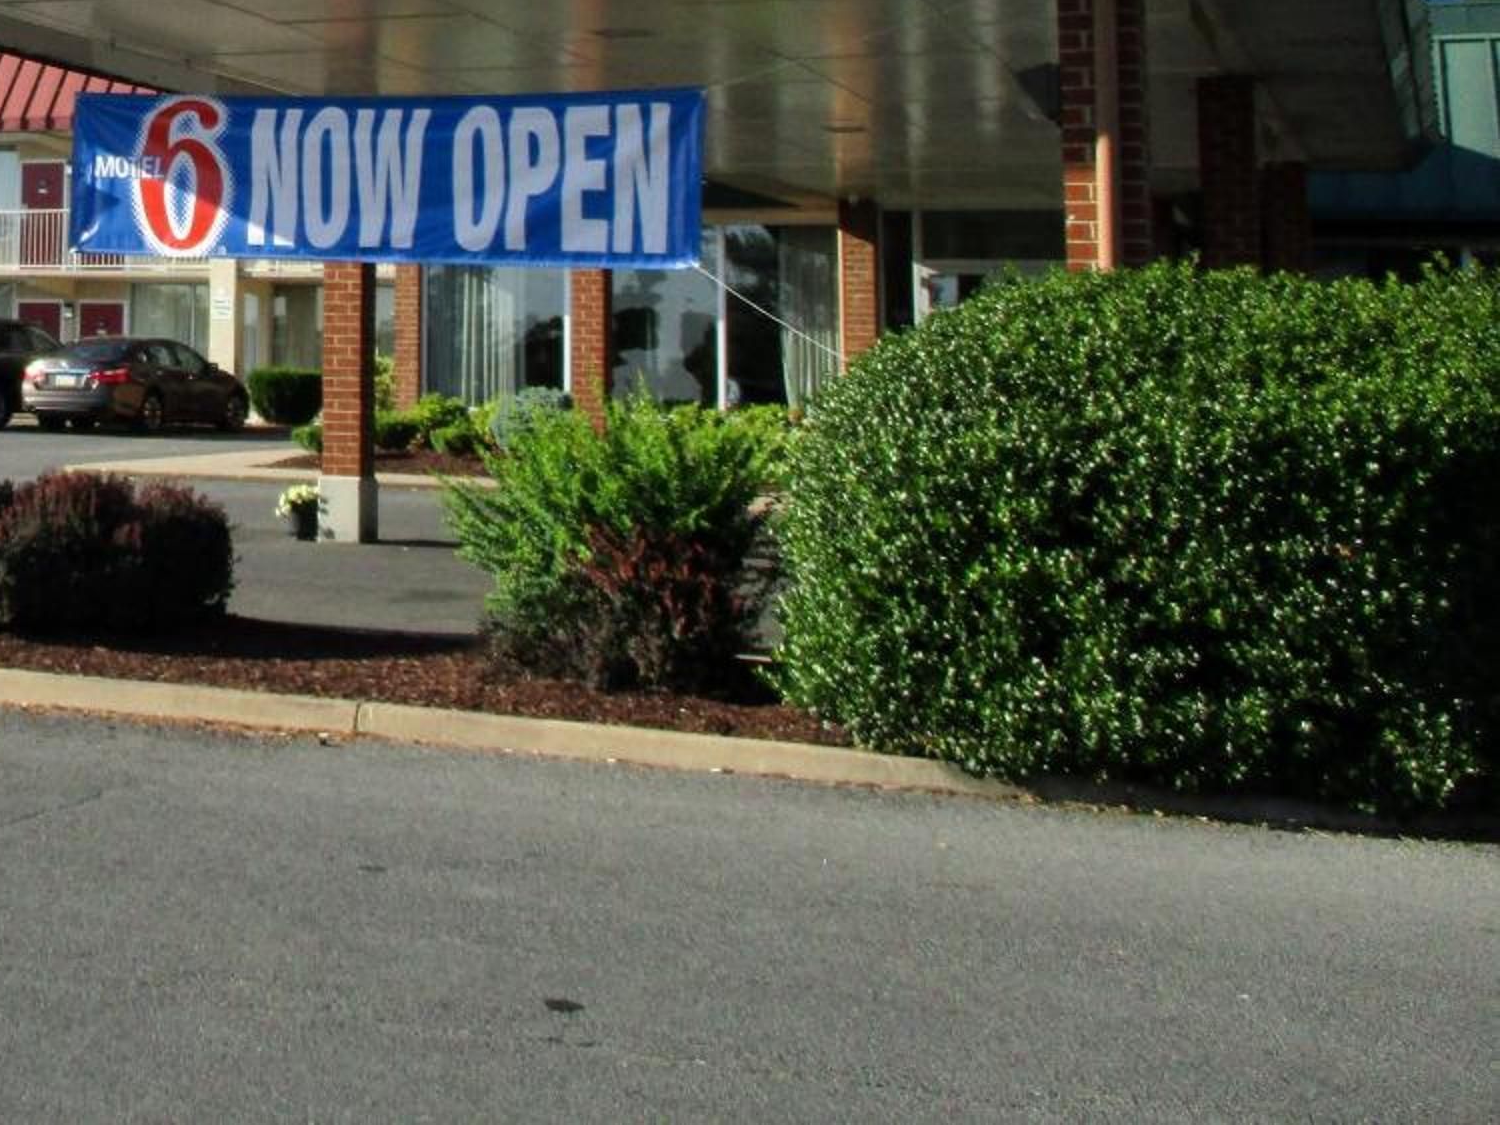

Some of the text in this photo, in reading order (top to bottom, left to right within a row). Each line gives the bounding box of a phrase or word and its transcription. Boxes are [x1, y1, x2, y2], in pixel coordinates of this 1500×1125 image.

[94, 96, 230, 255] MOTEL 6
[247, 103, 672, 255] NOW OPEN
